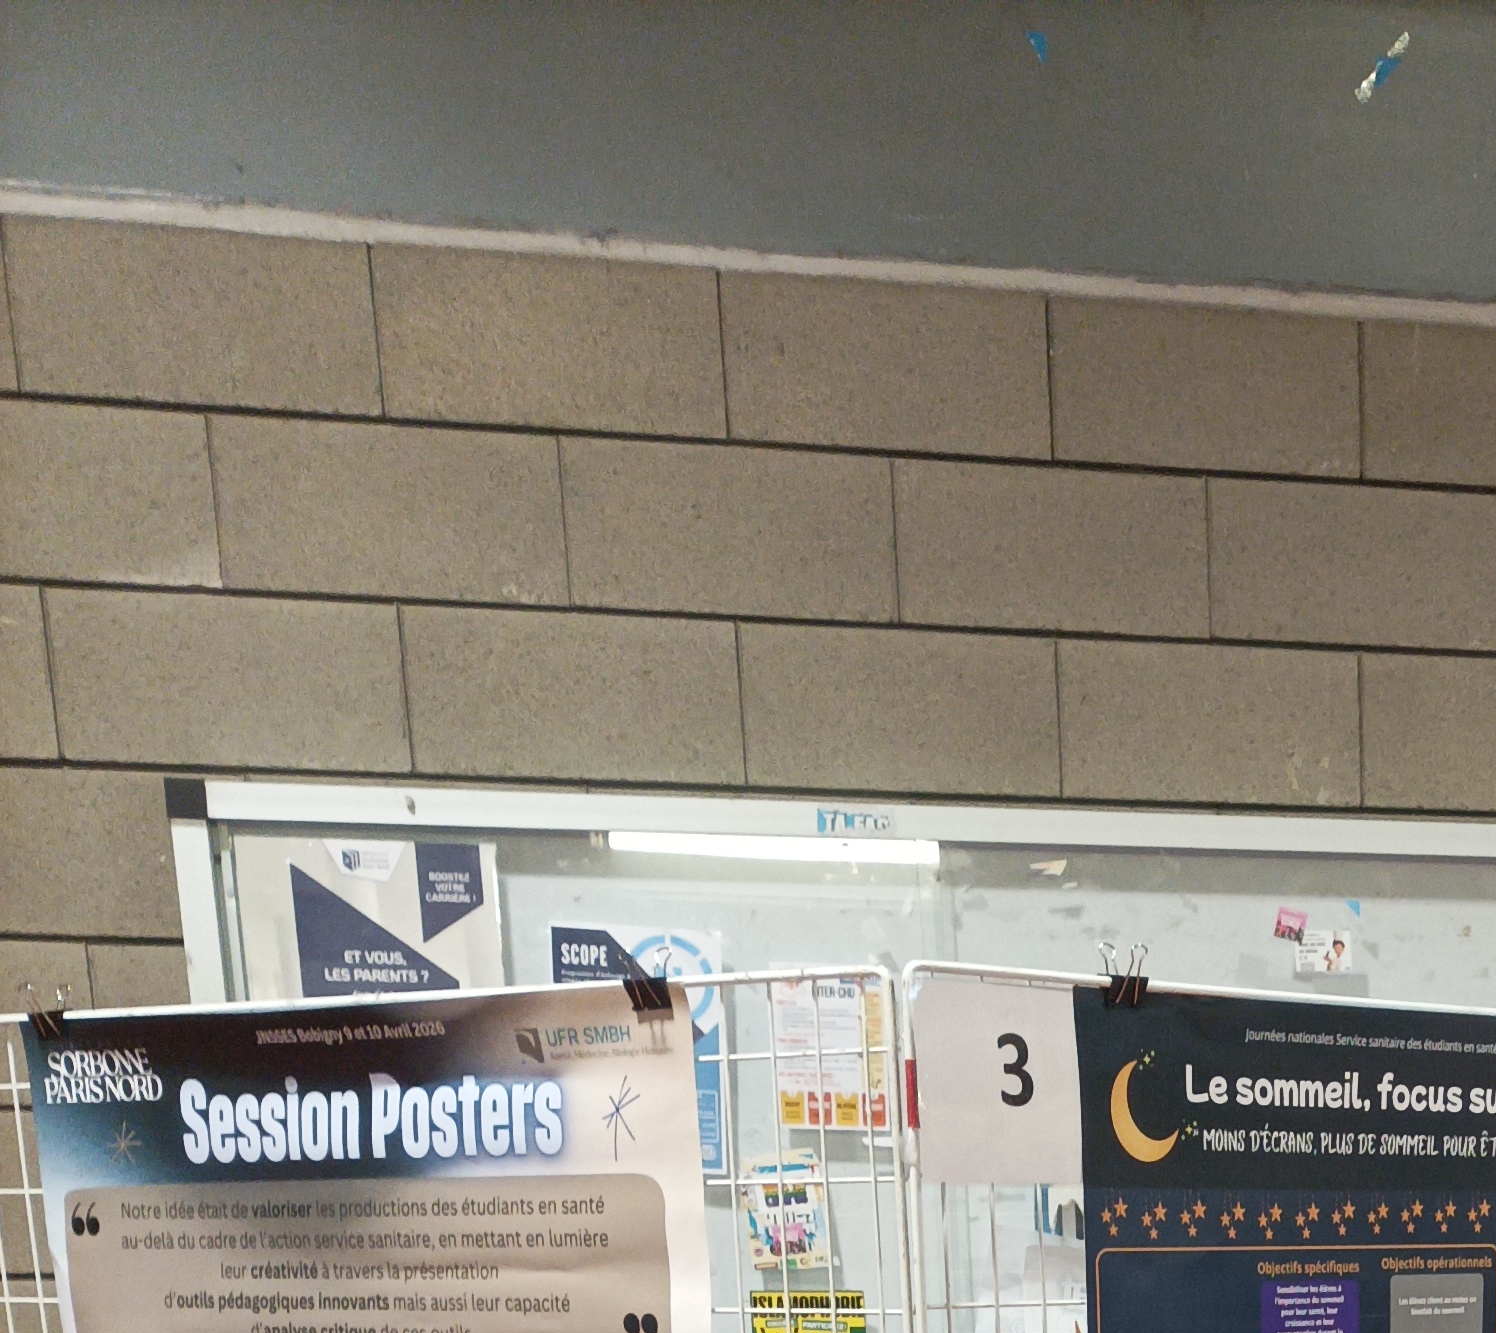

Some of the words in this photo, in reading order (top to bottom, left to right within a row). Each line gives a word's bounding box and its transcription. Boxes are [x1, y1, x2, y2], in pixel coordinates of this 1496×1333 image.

[561, 943, 608, 967] SCOPE
[325, 968, 350, 981] LES
[354, 969, 418, 983] PARENTS
[421, 970, 430, 984] ?
[546, 1029, 579, 1048] UFR
[584, 1025, 631, 1045] SMBH
[996, 1033, 1035, 1107] 3
[44, 1075, 103, 1104] PARIS
[104, 1074, 162, 1103] NORD
[1184, 1064, 1229, 1104] Le
[1235, 1071, 1372, 1112] sommeil,
[1377, 1072, 1463, 1112] focus
[179, 1075, 360, 1164] Session
[369, 1072, 564, 1160] Posters
[1202, 1130, 1246, 1153] MOINS
[1320, 1132, 1355, 1155] PLUS
[1357, 1134, 1377, 1155] DE
[1379, 1134, 1438, 1157] SOMMEIL
[1443, 1136, 1476, 1158] POUR
[121, 1201, 161, 1219] Notre
[165, 1200, 195, 1219] idée
[231, 1200, 248, 1218] de
[251, 1199, 311, 1218] valoriser
[316, 1199, 335, 1217] les
[339, 1198, 427, 1222] productions
[431, 1198, 457, 1216] des
[461, 1197, 533, 1216] étudiants
[538, 1201, 557, 1215] en
[562, 1196, 605, 1215] santé
[121, 1231, 174, 1250] au-delà
[177, 1231, 195, 1250] du
[199, 1231, 236, 1250] cadre
[240, 1231, 255, 1249] de
[260, 1230, 310, 1249] l'action
[314, 1230, 364, 1249] service
[368, 1230, 435, 1254] sanitaire,
[438, 1234, 457, 1248] en
[461, 1229, 522, 1248] mettant
[526, 1234, 544, 1248] en
[549, 1228, 609, 1248] lumière
[1256, 1261, 1302, 1277] Objectifs
[1304, 1259, 1360, 1276] spécifiques
[1380, 1257, 1425, 1273] Objectifs
[1427, 1255, 1493, 1272] opérationnels
[164, 1292, 214, 1310] d'outils
[219, 1292, 315, 1315] pédagogiques
[318, 1292, 389, 1311] innovants
[394, 1293, 426, 1311] mais
[431, 1293, 468, 1312] aussi
[472, 1293, 500, 1312] leur
[505, 1293, 570, 1318] capacité
